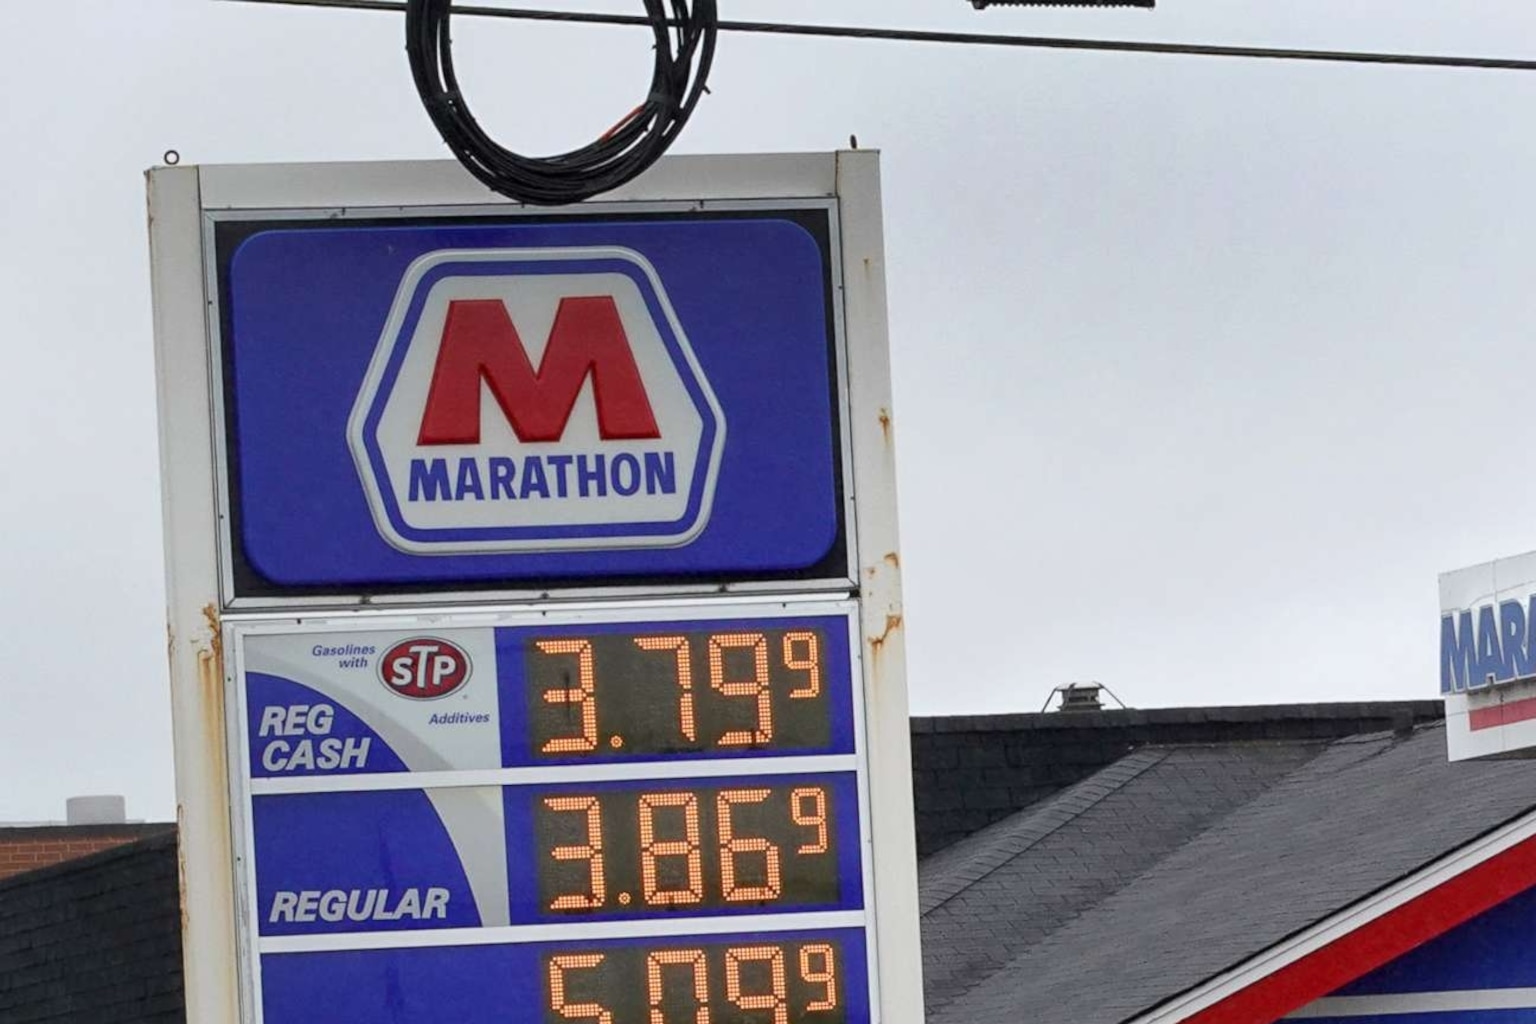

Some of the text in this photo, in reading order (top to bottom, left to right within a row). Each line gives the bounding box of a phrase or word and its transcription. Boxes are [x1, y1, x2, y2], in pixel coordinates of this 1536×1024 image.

[417, 294, 661, 446] M
[407, 450, 677, 503] MARATHON
[311, 643, 376, 658] Gasolines
[338, 657, 368, 669] with
[391, 645, 456, 689] STP
[259, 703, 334, 737] REG
[428, 712, 490, 726] Additives
[262, 737, 371, 772] CASH
[269, 886, 450, 924] REGULAR
